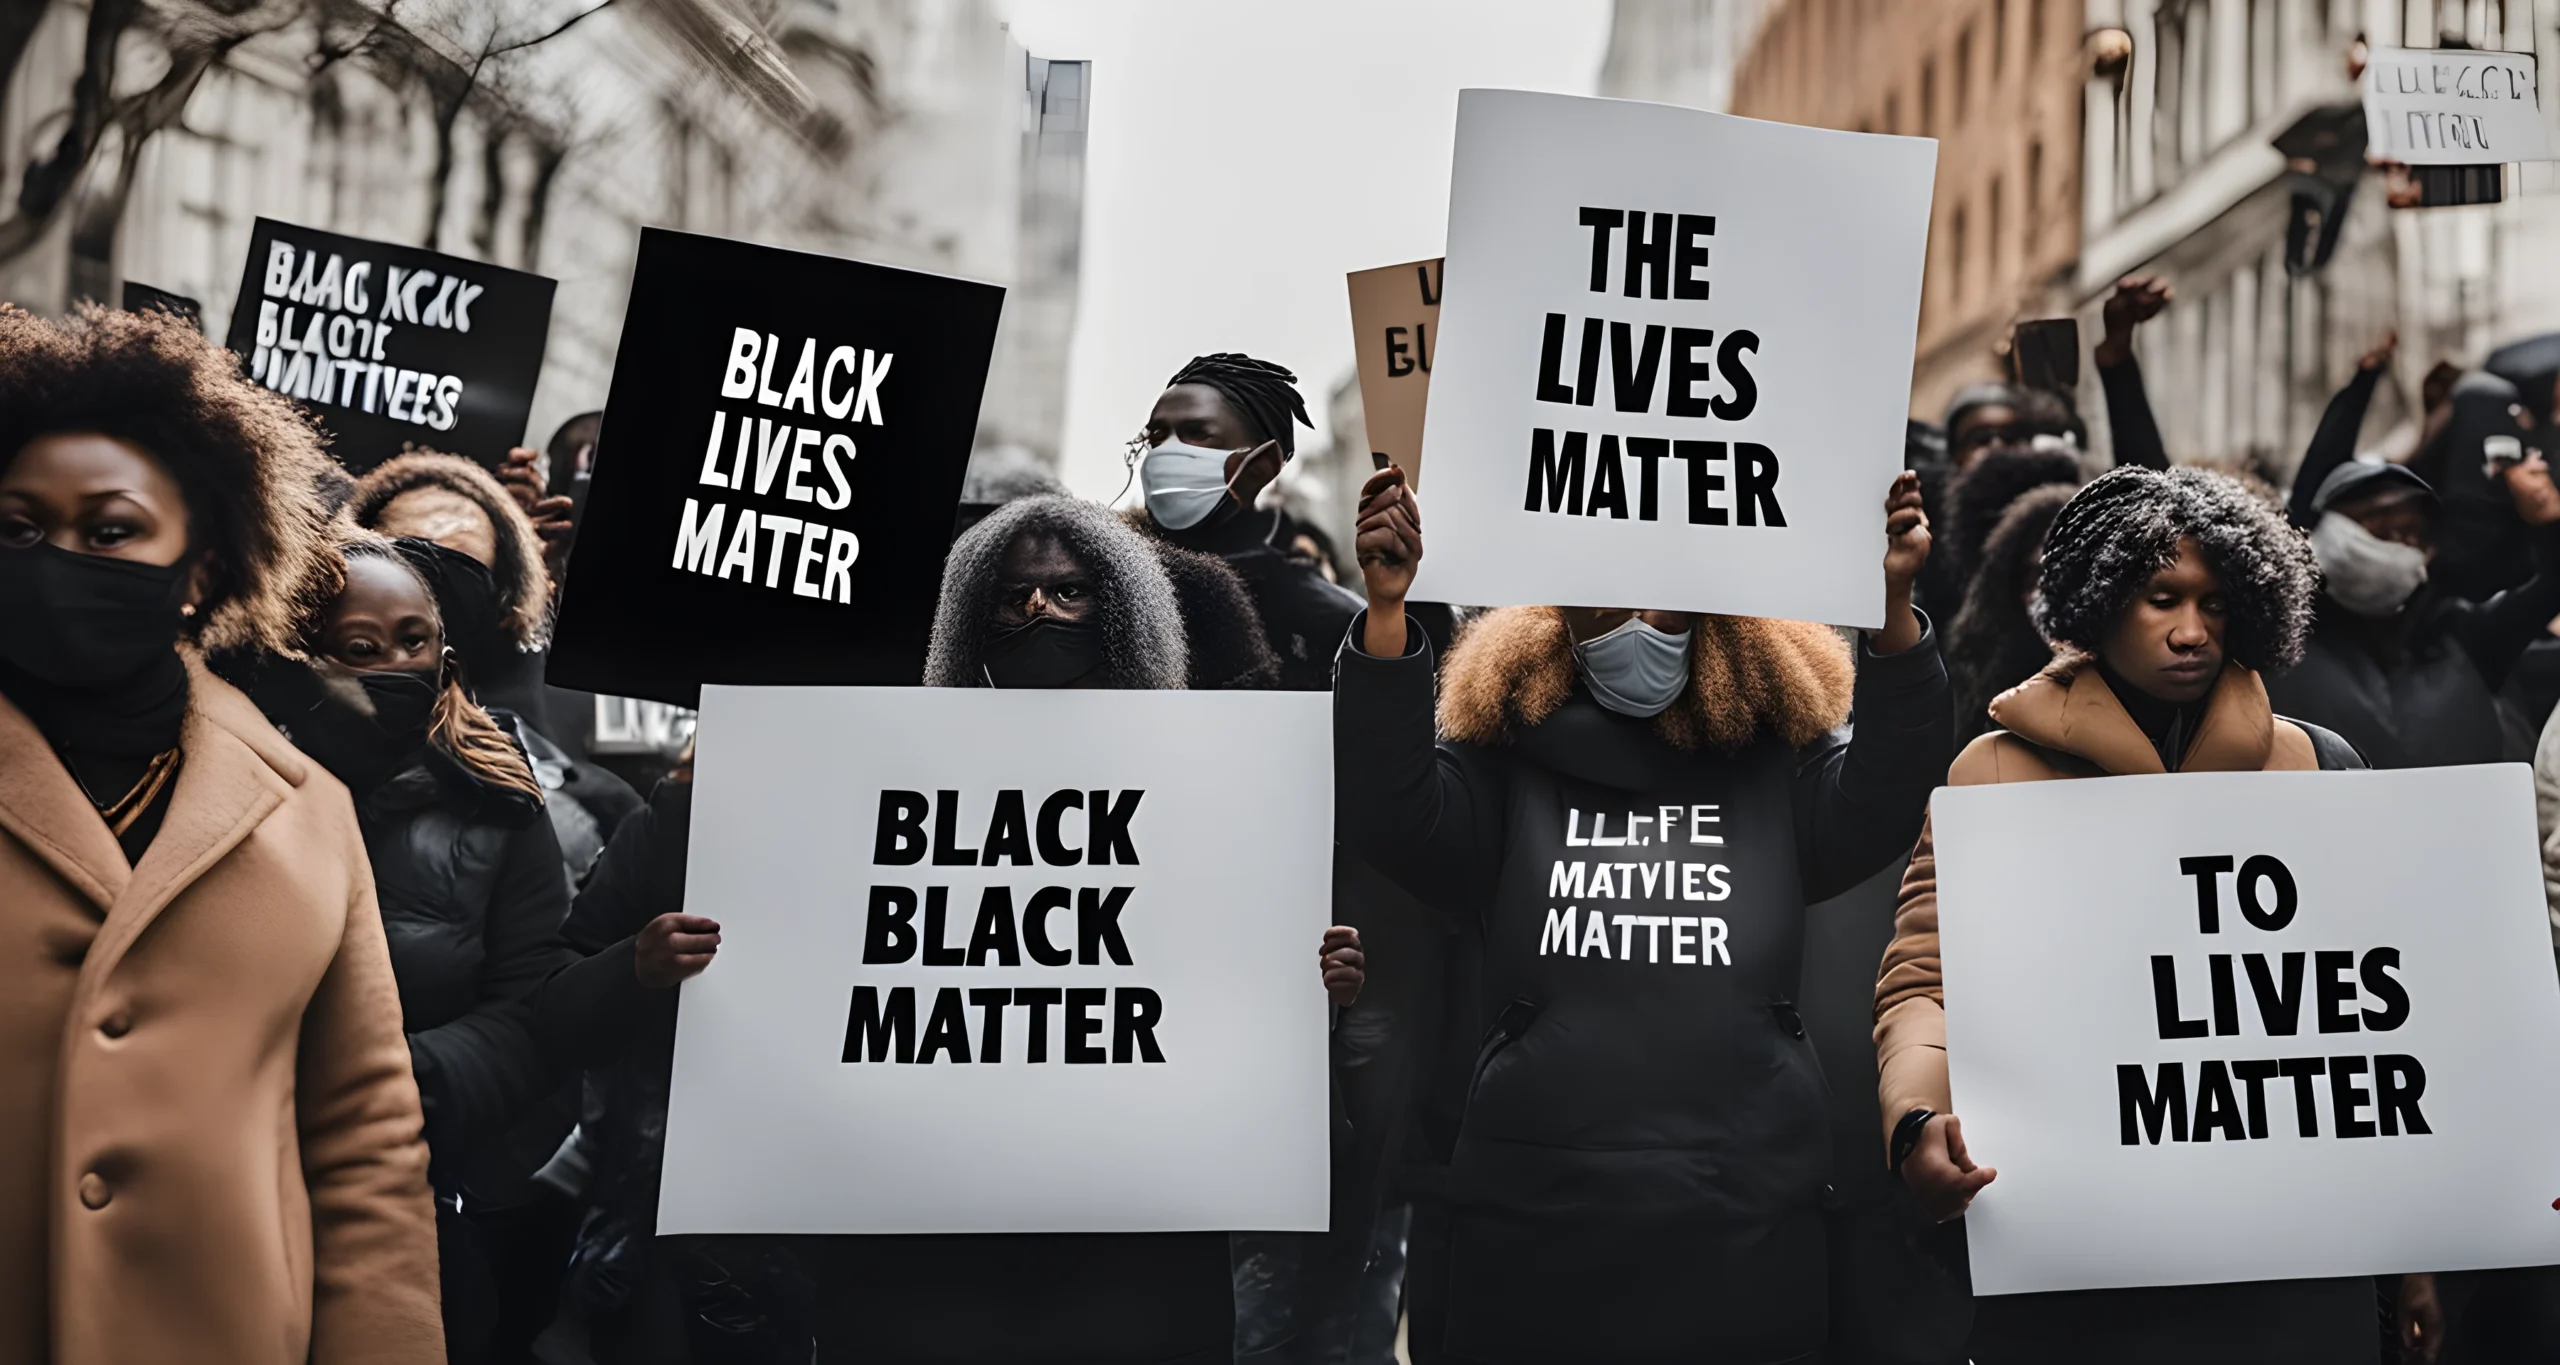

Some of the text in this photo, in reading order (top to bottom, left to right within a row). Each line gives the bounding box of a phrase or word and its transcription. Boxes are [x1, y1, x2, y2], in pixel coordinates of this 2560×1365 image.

[1580, 207, 1717, 301] THE
[721, 327, 894, 427] BLACK
[1537, 312, 1760, 422] LIVES
[698, 410, 857, 511] LIVES
[1525, 427, 1788, 528] MATTER
[673, 498, 860, 605] MATER
[872, 788, 1146, 867] BLACK
[861, 885, 1136, 967] BLACK
[1539, 905, 1732, 966] MATTER
[2179, 854, 2299, 934] TO
[841, 985, 1167, 1065] MATTER
[2150, 946, 2411, 1040] LIVES
[2116, 1053, 2433, 1146] MATTER
